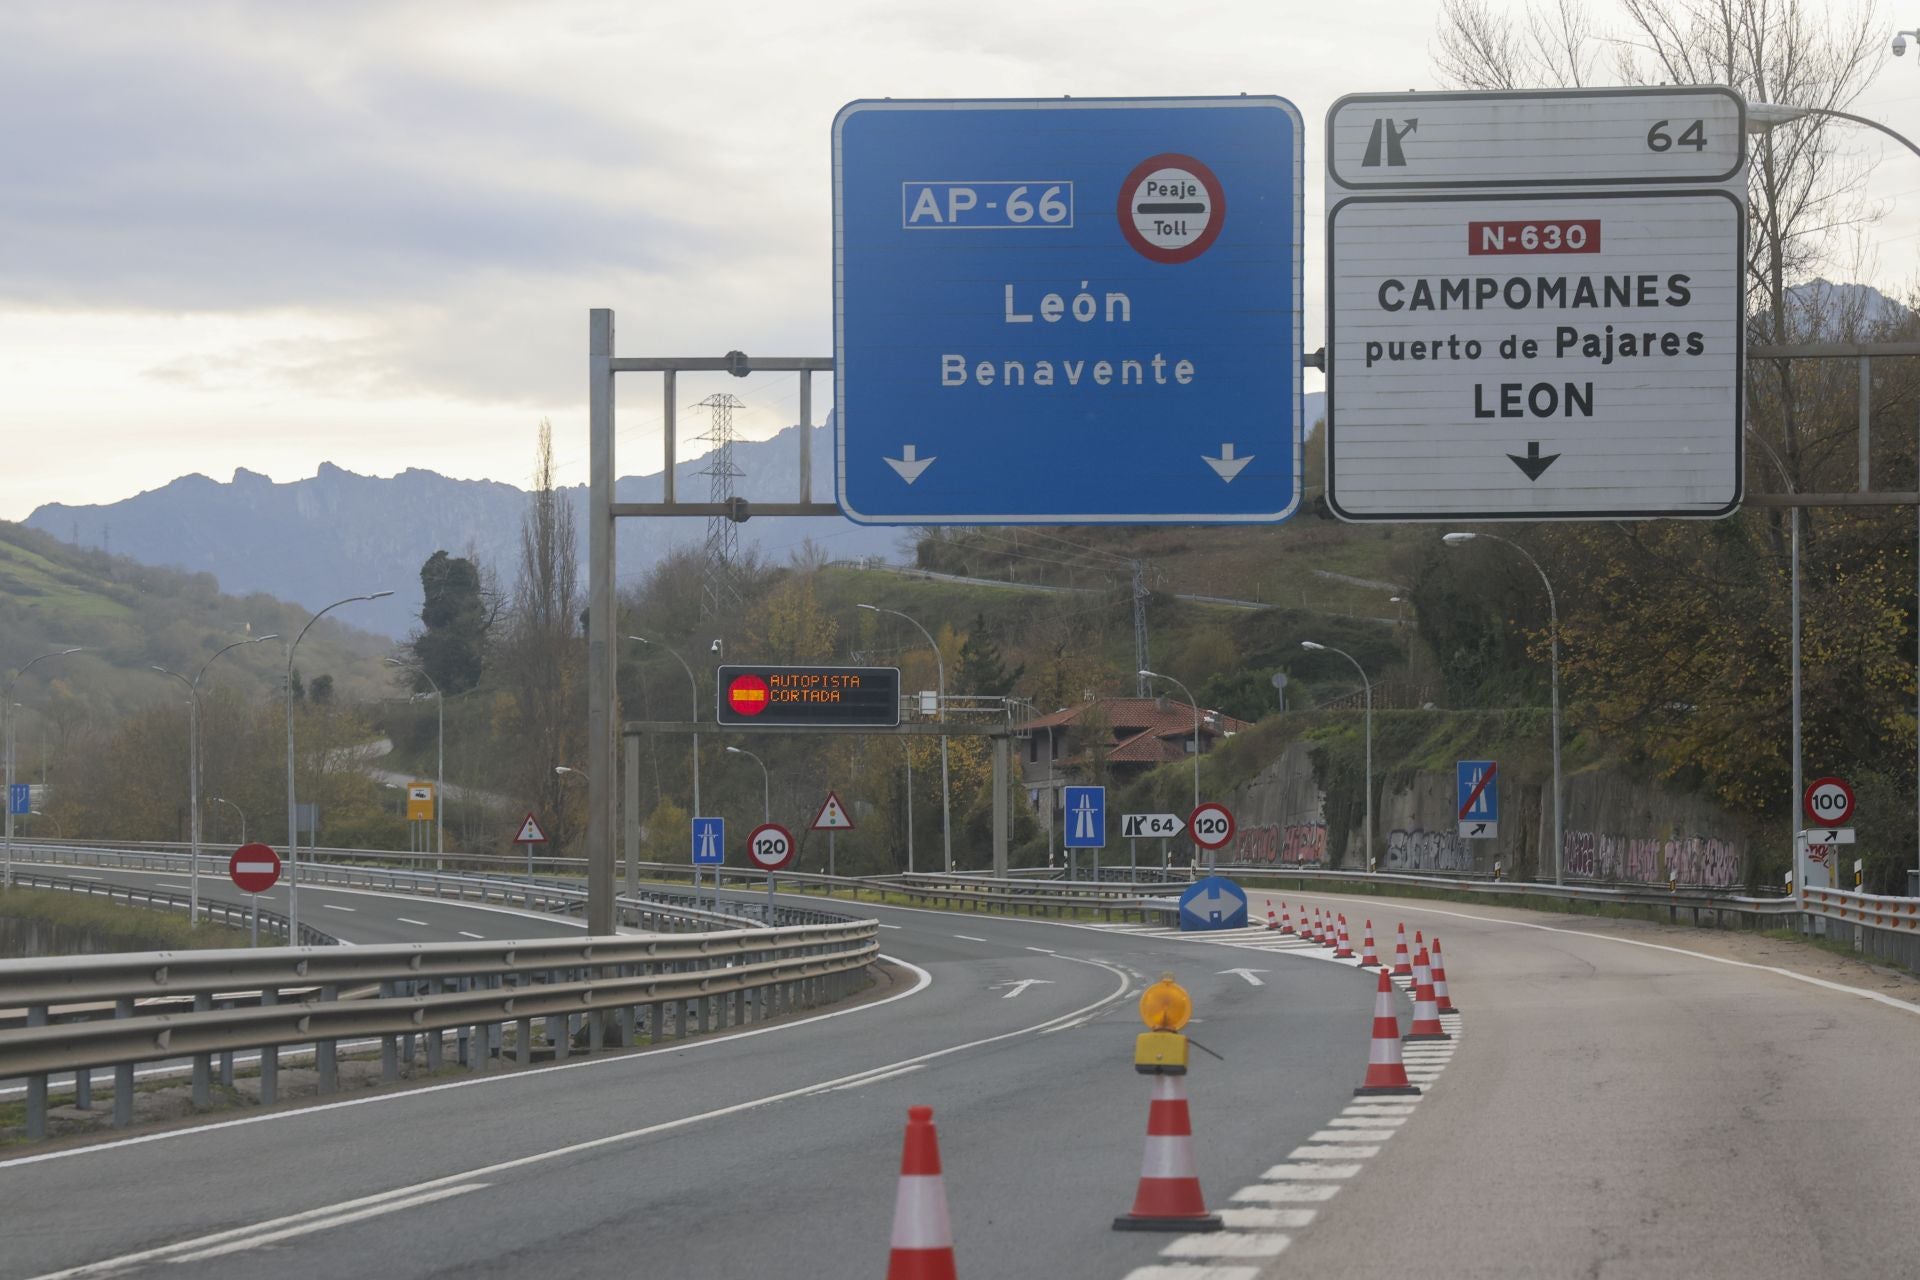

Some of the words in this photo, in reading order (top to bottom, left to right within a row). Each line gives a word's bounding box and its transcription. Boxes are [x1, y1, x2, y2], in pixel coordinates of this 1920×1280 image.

[1647, 120, 1707, 152] 64
[1147, 181, 1197, 199] Peaje
[910, 186, 1066, 222] AP-66
[1154, 220, 1188, 236] Toll
[1483, 225, 1587, 251] N-630
[1005, 281, 1131, 323] León
[1378, 274, 1691, 312] CAMPOMANES
[1366, 334, 1482, 367] puerto
[1500, 335, 1539, 360] de
[1557, 325, 1705, 365] Pajares
[941, 353, 1195, 386] Benavente
[1474, 382, 1594, 418] LEON
[770, 675, 860, 688] AUTOPISTA
[770, 690, 841, 703] CORTADA
[1812, 793, 1847, 810] 100
[1150, 818, 1174, 833] 64
[1195, 818, 1228, 834] 120
[755, 839, 786, 855] 120
